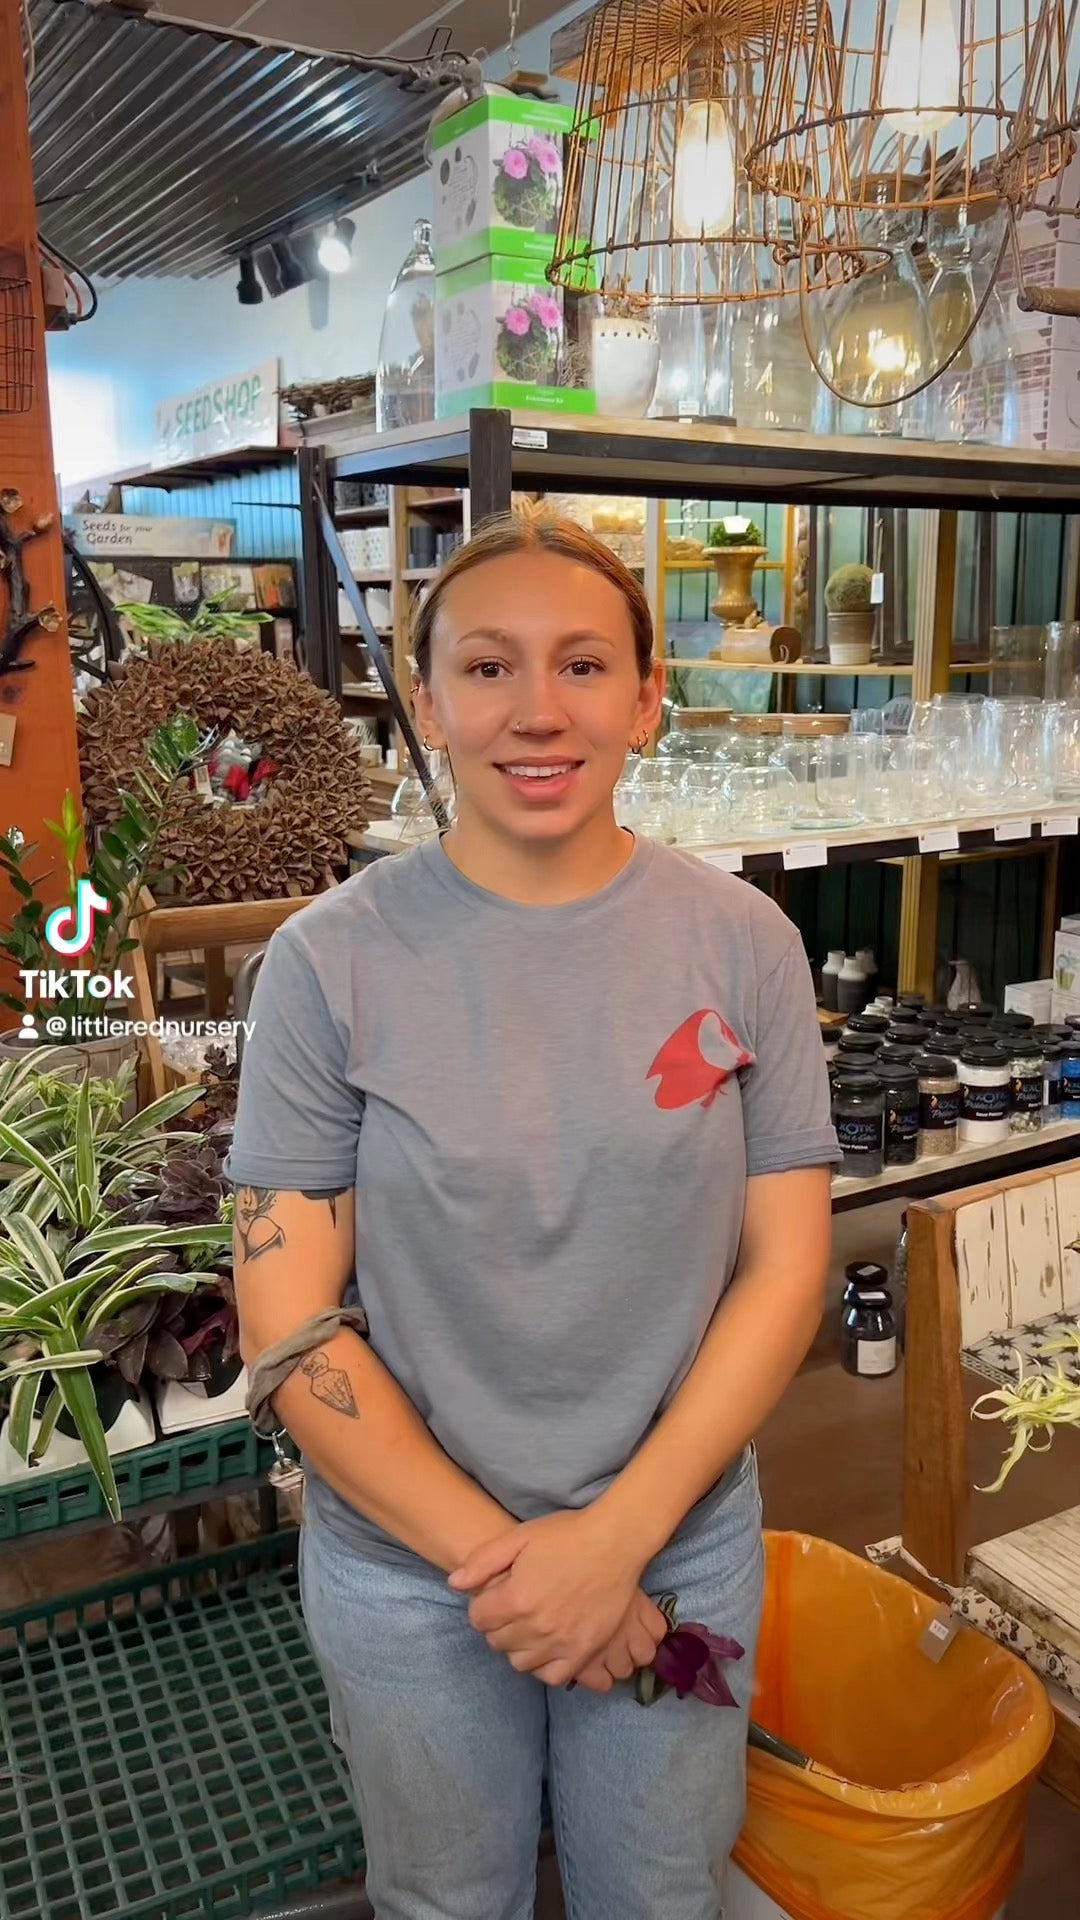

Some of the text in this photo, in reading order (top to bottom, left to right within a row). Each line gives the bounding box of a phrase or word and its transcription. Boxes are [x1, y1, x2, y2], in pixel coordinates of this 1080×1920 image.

[82, 520, 117, 532] Seeds
[120, 524, 131, 532] for
[86, 532, 133, 545] Garden
